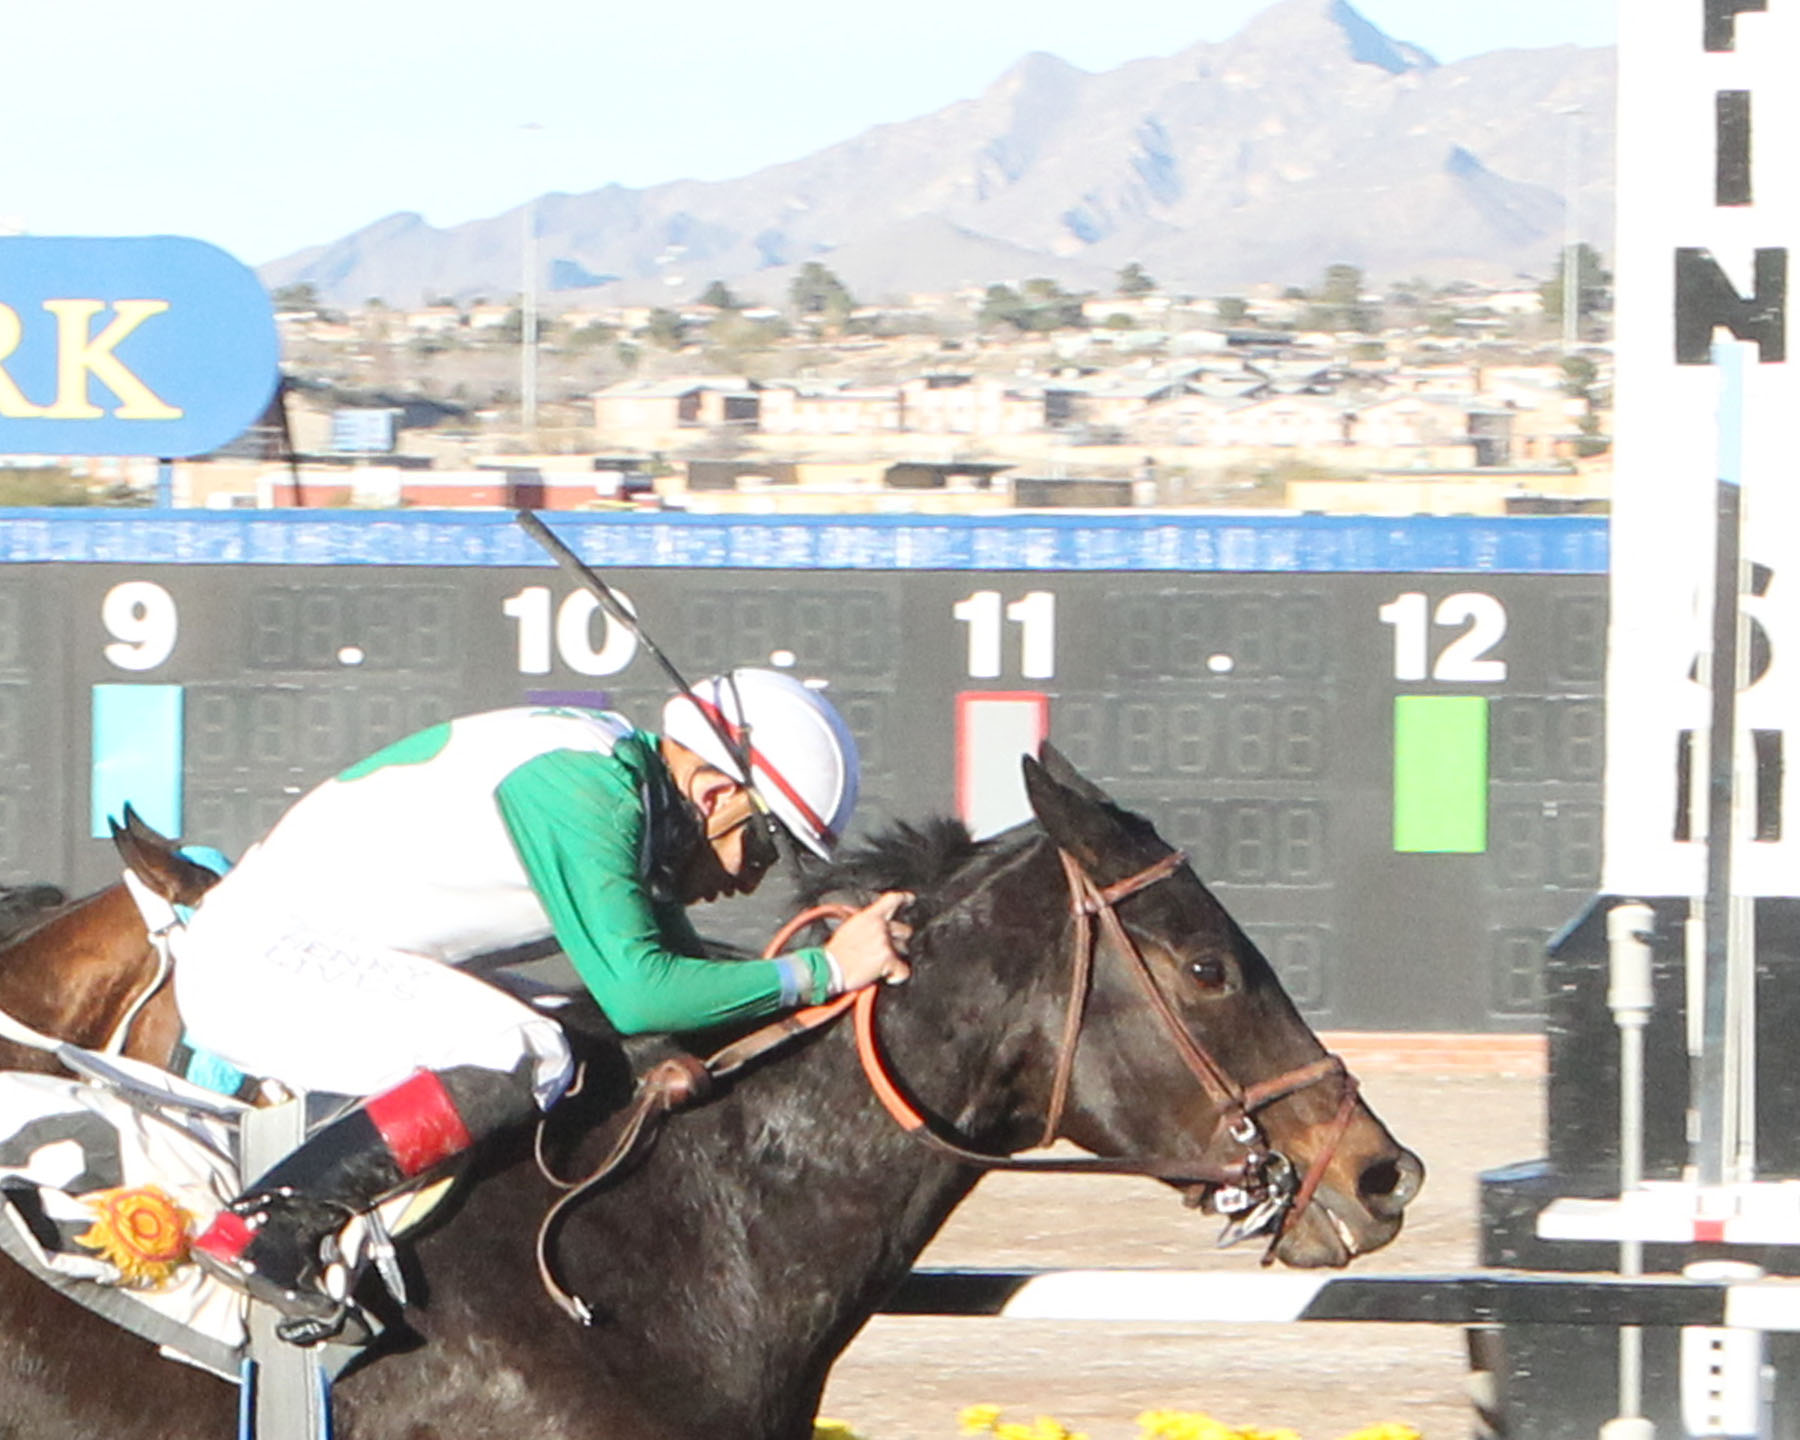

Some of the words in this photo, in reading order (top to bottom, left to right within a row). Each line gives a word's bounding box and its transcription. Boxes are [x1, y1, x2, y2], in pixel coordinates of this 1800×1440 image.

[103, 581, 178, 671] 9
[504, 586, 640, 676] 10
[954, 591, 1055, 679] 11
[1379, 593, 1507, 682] 12
